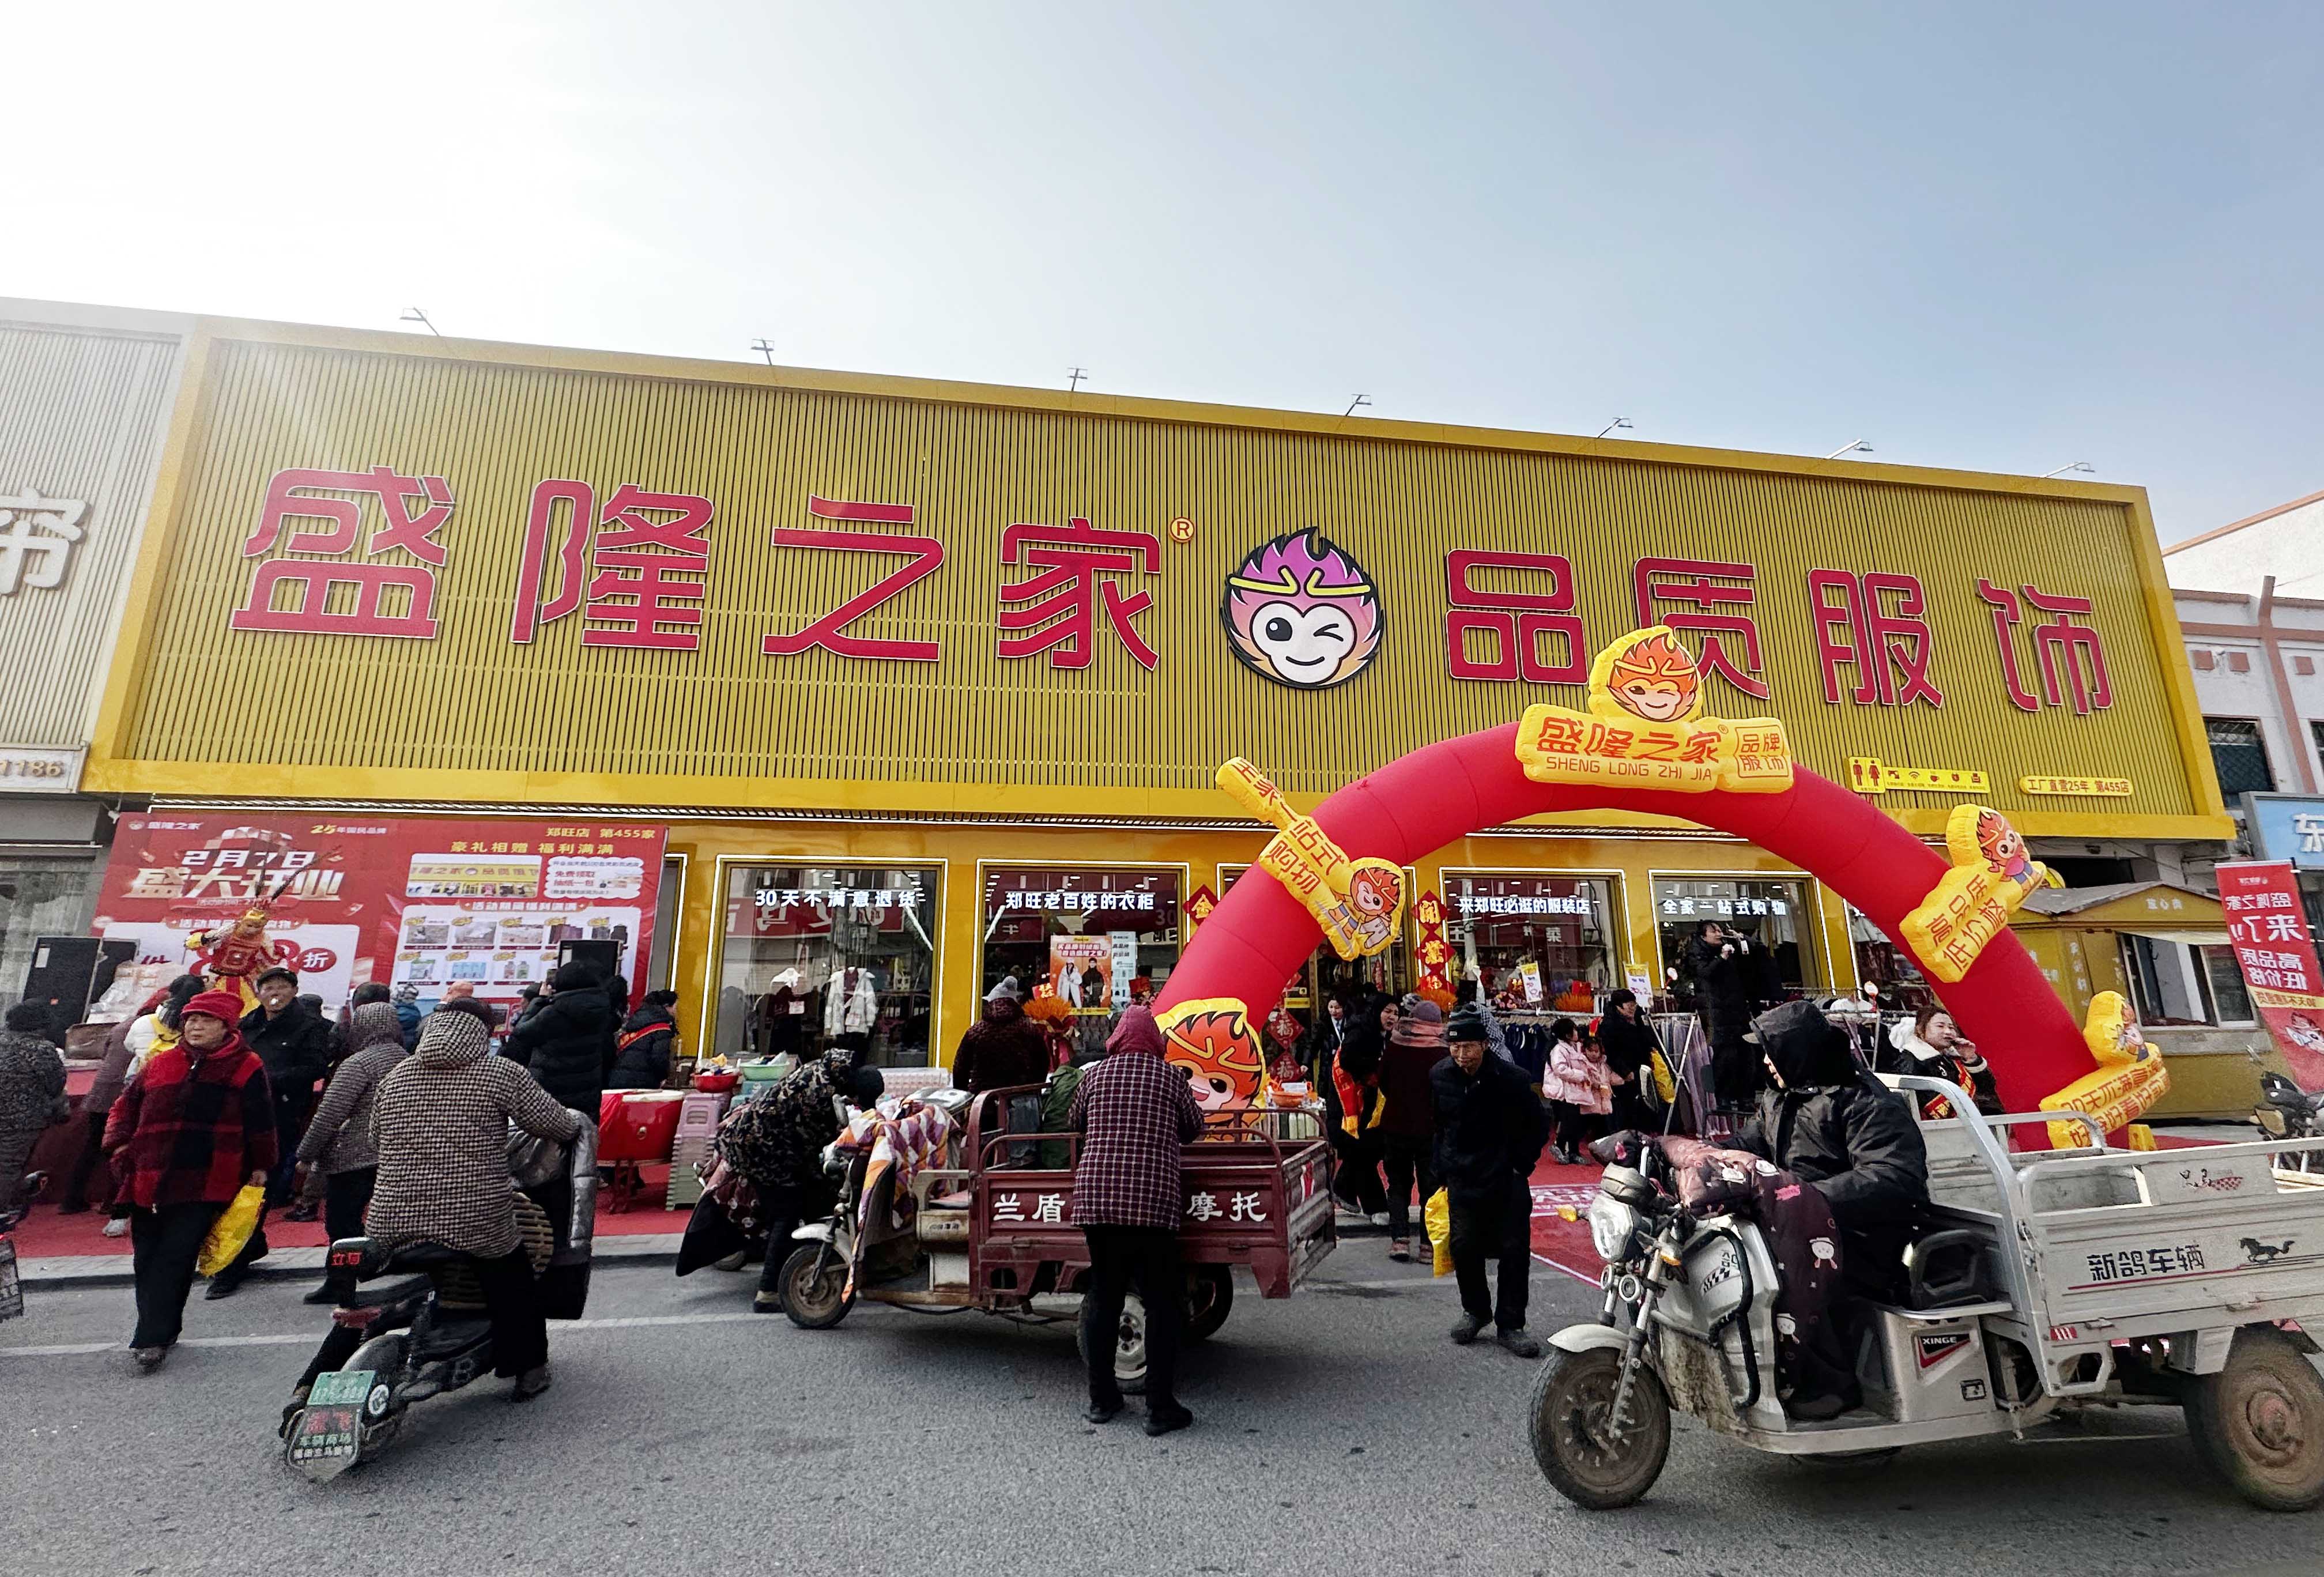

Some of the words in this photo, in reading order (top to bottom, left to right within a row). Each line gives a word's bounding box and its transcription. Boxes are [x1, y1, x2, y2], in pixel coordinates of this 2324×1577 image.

[231, 465, 1161, 671] 盛隆之家
[1446, 548, 2112, 716] 品质服饰
[1536, 716, 1722, 765] 盛隆之家
[1741, 733, 1781, 753] 品牌
[1546, 757, 1600, 774] SHENG
[1609, 762, 1649, 776] LONG
[1658, 764, 1682, 779] ZHI
[1691, 766, 1712, 781] JIA
[1742, 754, 1784, 772] 服饰
[2095, 780, 2129, 793] 第455店
[599, 828, 655, 839] 第455家
[450, 841, 528, 853] 豪礼相赠
[538, 843, 613, 854] 福利满满
[182, 850, 315, 868] 2月7日
[1265, 840, 1321, 895] 购物
[121, 866, 345, 901] 盛大开业
[755, 890, 916, 908] 30天不满意退货
[1006, 892, 1154, 910] 郑旺老百姓的衣柜
[1459, 897, 1590, 914] 来郑旺必逛的服装店
[1663, 899, 1786, 915] 全家一站式购物
[1925, 874, 1987, 947] 高品质
[1942, 897, 2008, 972] 低价格
[304, 952, 329, 968] 折
[993, 1193, 1066, 1223] 兰盾
[1186, 1191, 1267, 1222] 摩托
[1922, 1337, 1957, 1345] XINGE
